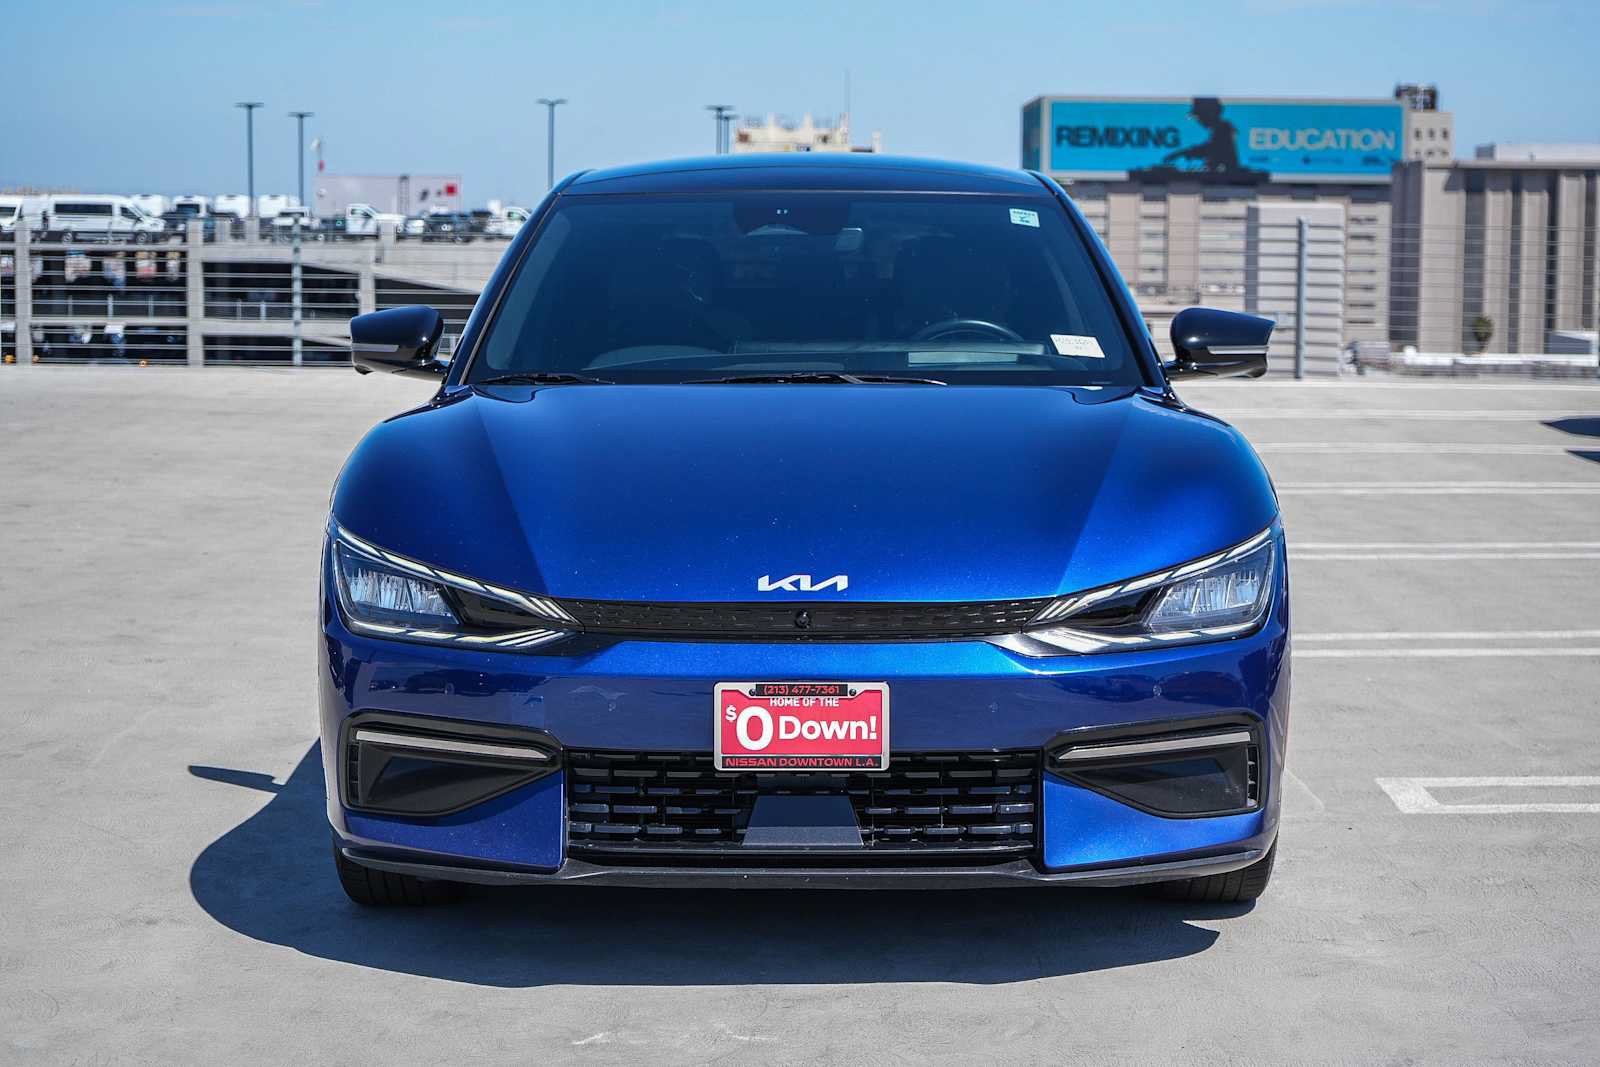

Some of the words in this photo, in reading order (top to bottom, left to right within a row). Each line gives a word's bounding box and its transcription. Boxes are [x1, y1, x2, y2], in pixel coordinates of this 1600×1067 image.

[1056, 125, 1181, 148] REMIXING
[1248, 127, 1396, 152] EDUCATION
[763, 684, 790, 696] (213)
[791, 684, 840, 696] 477-7361
[769, 697, 800, 707] HOME
[802, 697, 815, 707] OF
[819, 697, 839, 707] THE
[779, 715, 877, 740] Down!
[725, 757, 777, 767] NISSAN
[779, 757, 852, 767] DOWNTOWN
[855, 757, 879, 767] L.A.
